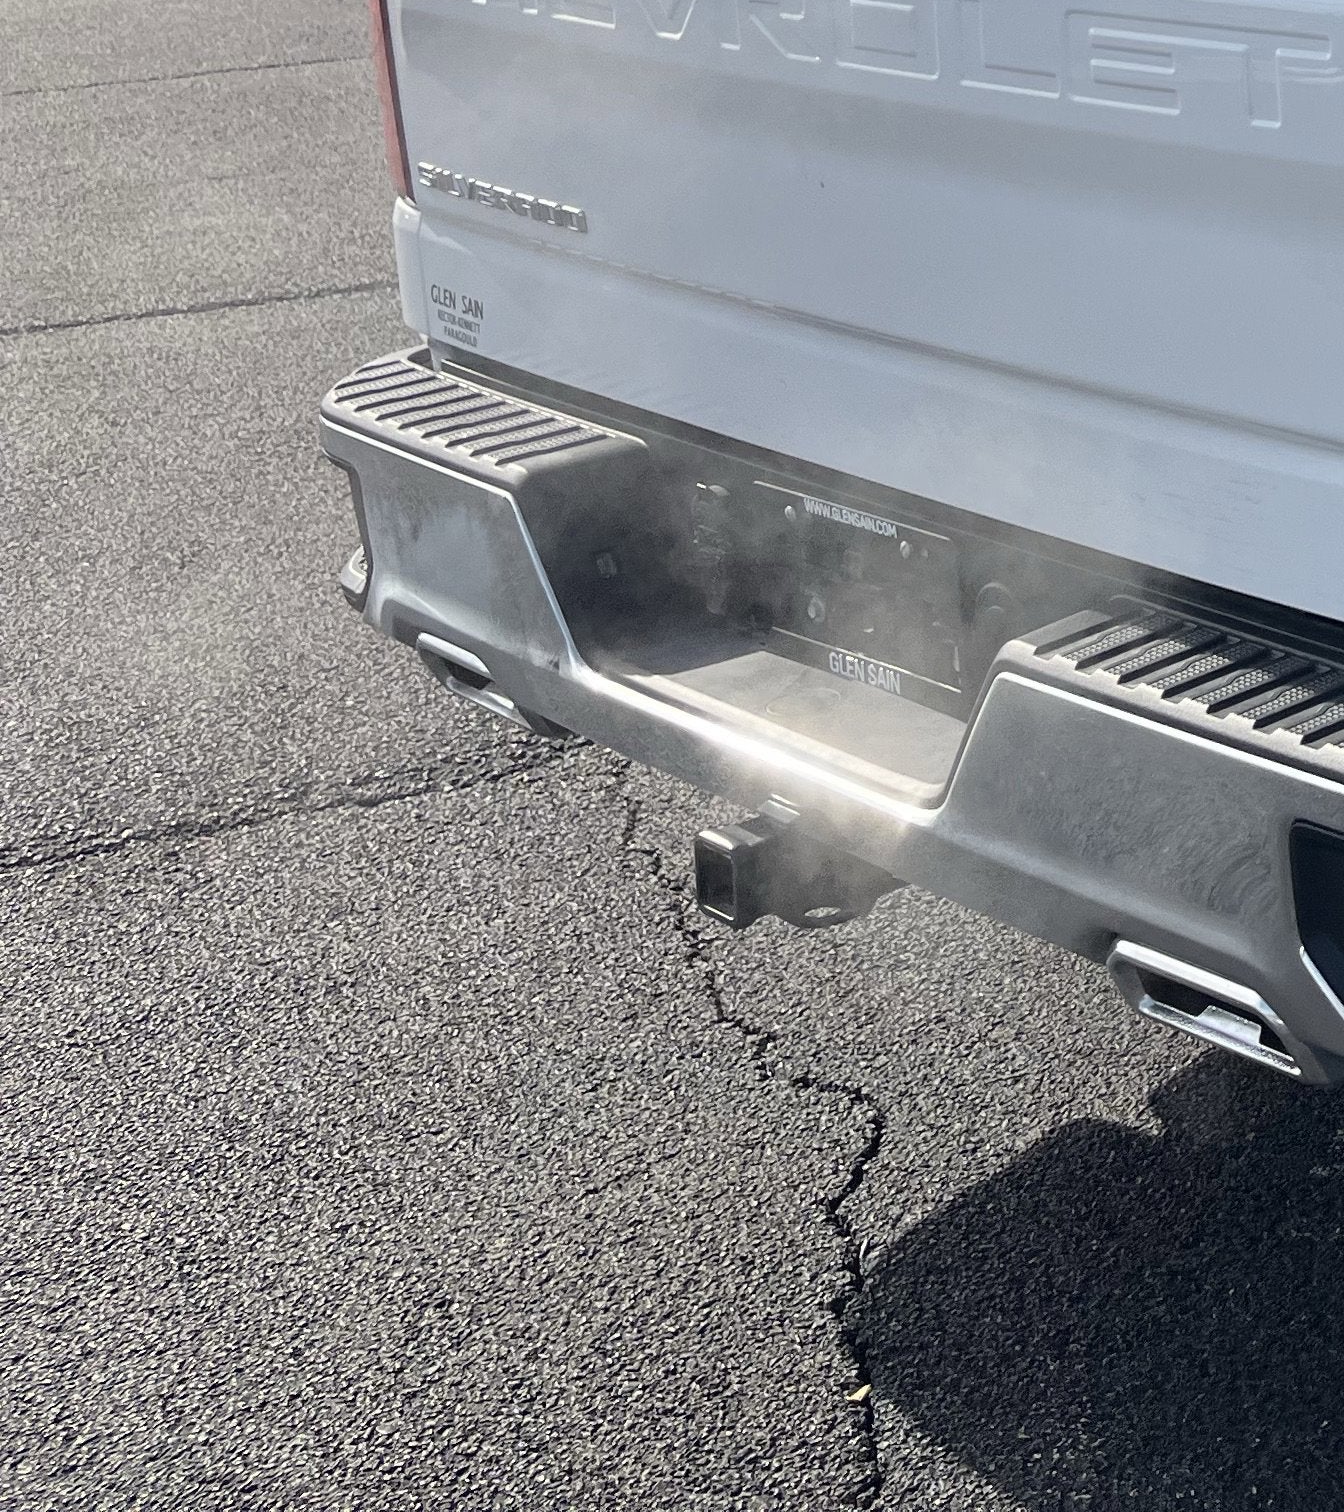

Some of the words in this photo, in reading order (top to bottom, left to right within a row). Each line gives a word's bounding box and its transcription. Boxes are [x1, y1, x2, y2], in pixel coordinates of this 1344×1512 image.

[431, 284, 457, 310] GLEN
[461, 295, 484, 320] SAIN
[803, 497, 898, 539] WWW.GLENSAIN.COM
[829, 651, 865, 682] GLEN
[867, 663, 901, 695] SAIN
